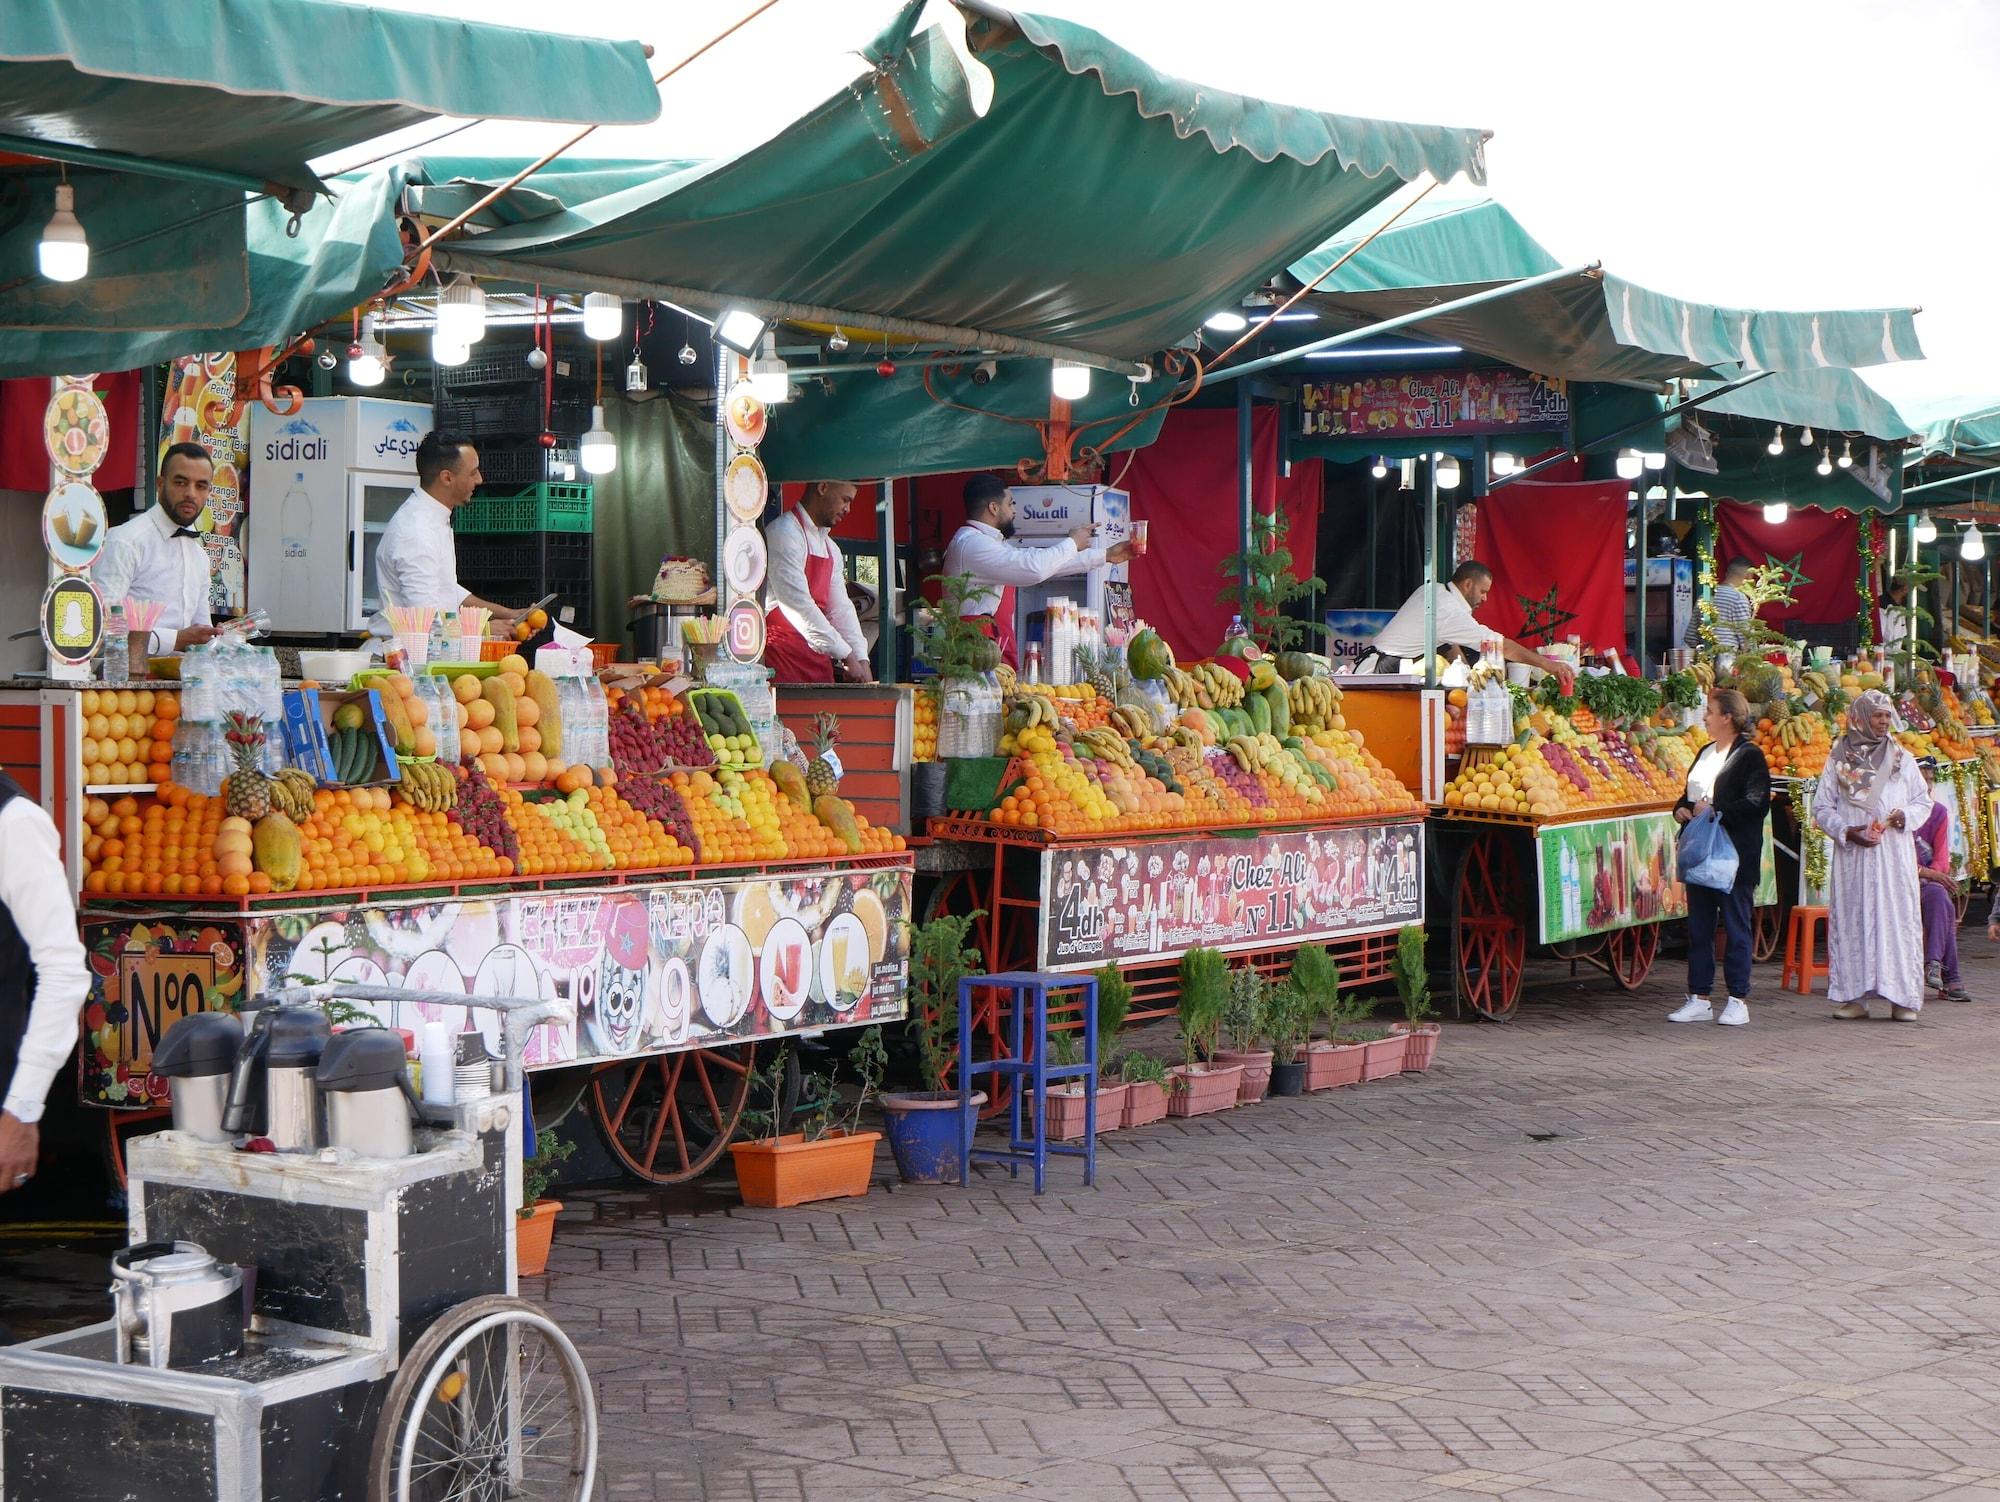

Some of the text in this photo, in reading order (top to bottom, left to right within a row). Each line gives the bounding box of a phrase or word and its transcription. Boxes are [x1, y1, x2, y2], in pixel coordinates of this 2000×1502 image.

[210, 383, 231, 395] Petit
[1409, 379, 1460, 399] Chez Ali
[1431, 400, 1453, 428] 11
[202, 434, 227, 448] Grand
[235, 440, 248, 452] Big
[266, 437, 327, 460] sidi ali
[212, 449, 235, 460] 20 dh
[222, 499, 244, 511] Small
[204, 532, 236, 546] Orange
[207, 547, 221, 557] and
[228, 549, 241, 561] Big
[219, 561, 230, 570] dh
[216, 584, 227, 594] dh
[216, 597, 226, 607] dh
[1333, 639, 1363, 657] Sidi
[1233, 851, 1306, 891] Chez Ali
[1245, 903, 1266, 936] N°
[1266, 890, 1294, 933] 11
[521, 895, 604, 952] CHEZ
[1057, 940, 1070, 955] Jus
[660, 957, 692, 1045] 9
